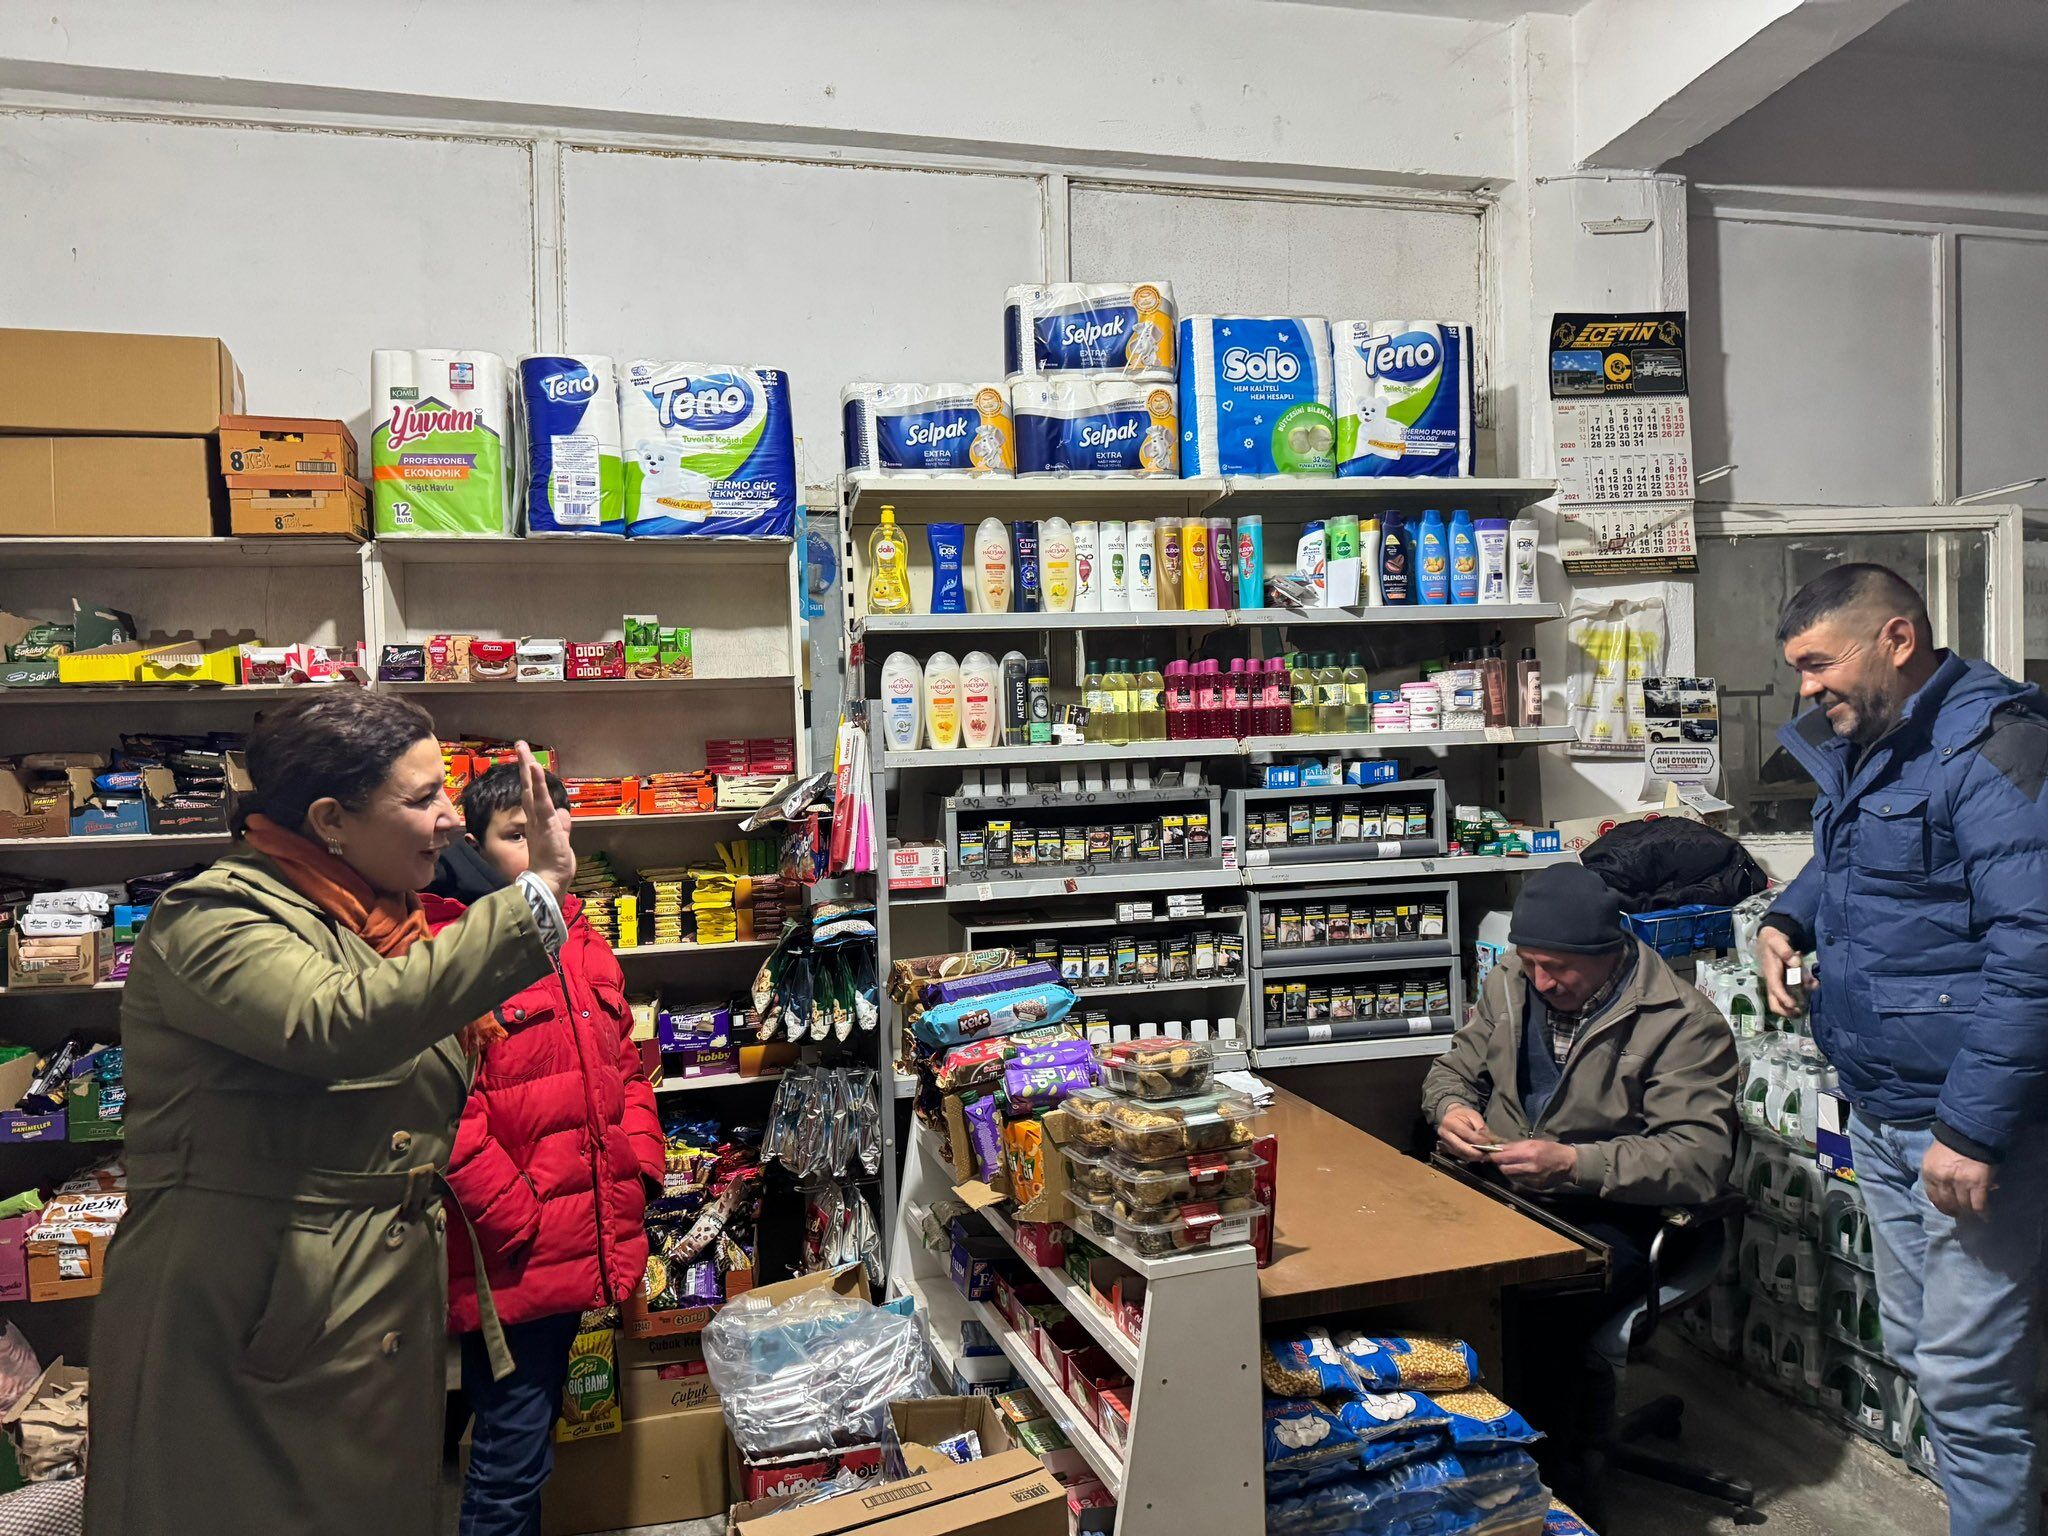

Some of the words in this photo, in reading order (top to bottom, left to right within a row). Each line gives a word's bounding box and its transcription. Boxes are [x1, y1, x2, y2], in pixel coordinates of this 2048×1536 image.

[1062, 315, 1124, 346] Selpak
[1362, 335, 1435, 378] Teno
[1224, 348, 1299, 381] Solo
[545, 373, 594, 399] Teno
[653, 376, 746, 428] Teno
[1042, 392, 1047, 400] 8
[388, 405, 474, 449] Yuvam
[905, 417, 968, 446] Selpak
[1079, 419, 1138, 448] Selpak
[682, 435, 714, 443] Tuvalet
[716, 436, 743, 445] Kağıdı
[230, 451, 244, 471] 8
[404, 457, 467, 465] PROFESYONEL
[404, 467, 461, 477] EKONOMİK
[406, 484, 428, 492] Kağıt
[709, 480, 750, 489] TERMO
[753, 480, 777, 493] GÜÇ
[393, 503, 410, 516] 12
[662, 499, 680, 507] DAHA
[275, 517, 284, 530] 8
[878, 545, 894, 553] dalin
[1517, 540, 1533, 549] ipek
[1017, 681, 1025, 719] MENTOR
[963, 798, 983, 808] 92
[1571, 838, 1585, 848] TSE
[896, 855, 917, 863] Sitil
[970, 870, 988, 880] 92
[697, 1052, 731, 1062] hobby
[64, 1181, 91, 1191] ikram
[68, 1199, 120, 1213] ikram
[37, 1231, 65, 1239] ikram
[673, 1311, 706, 1326] Gong
[650, 1337, 680, 1353] Çubuk
[569, 1378, 583, 1395] BIG
[585, 1374, 609, 1391] BANG
[671, 1384, 708, 1406] Çubuk
